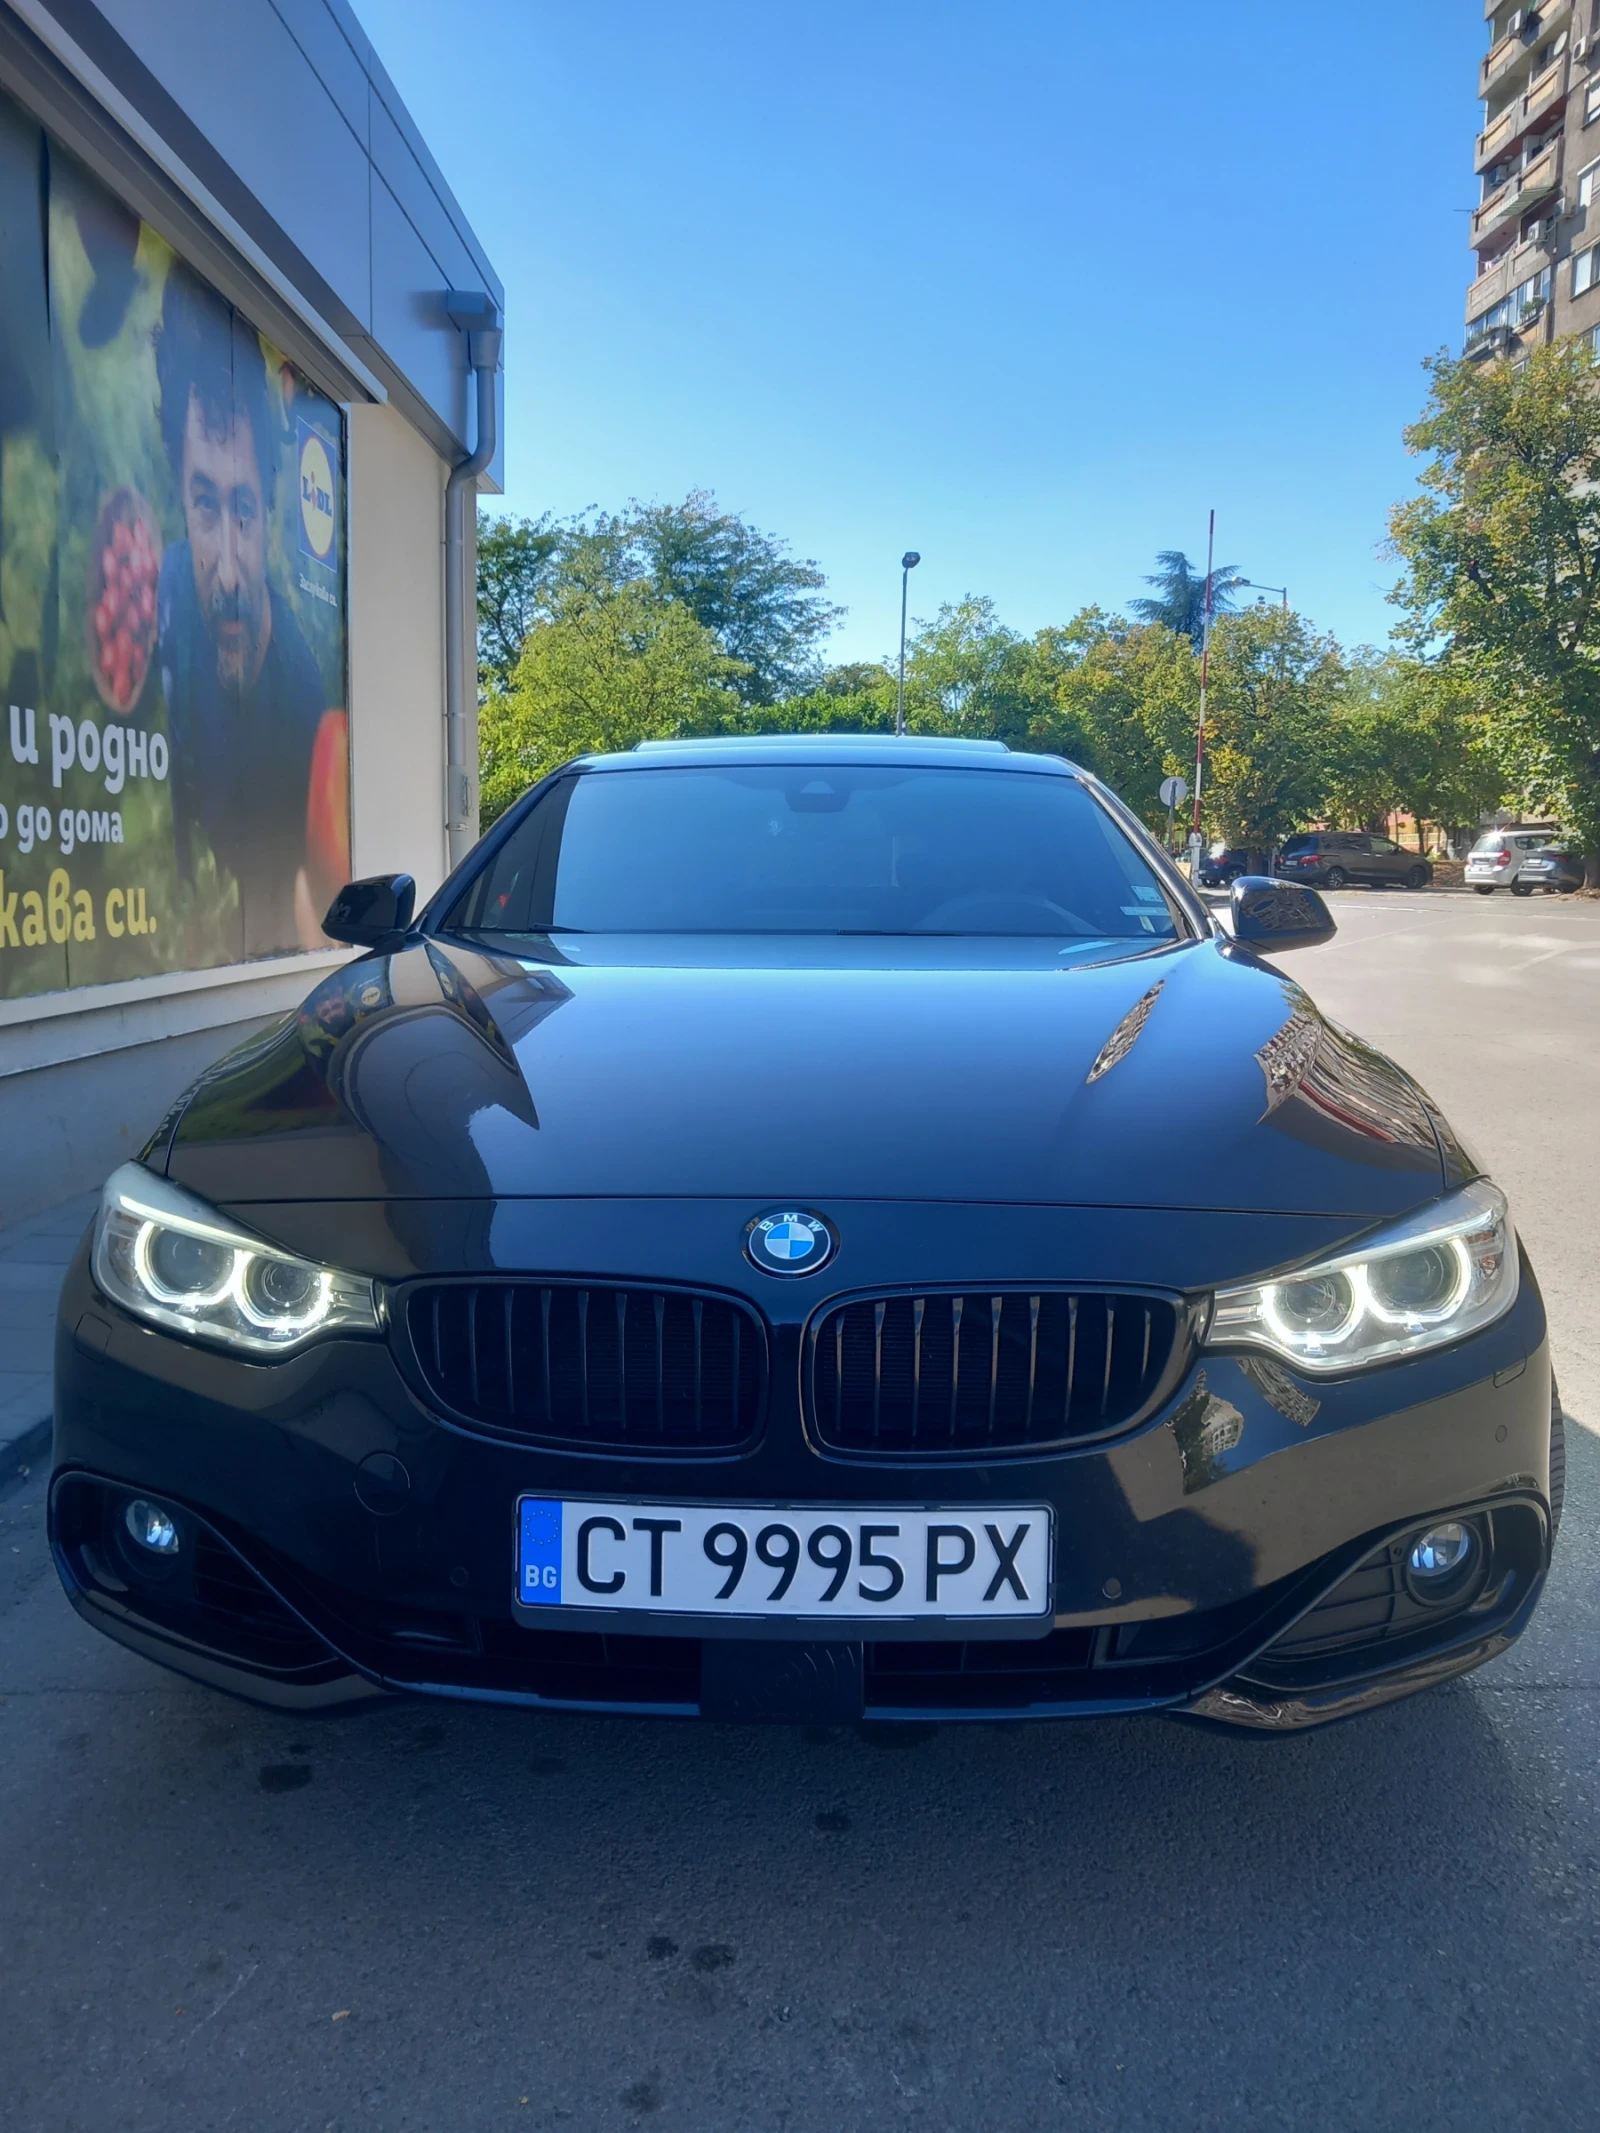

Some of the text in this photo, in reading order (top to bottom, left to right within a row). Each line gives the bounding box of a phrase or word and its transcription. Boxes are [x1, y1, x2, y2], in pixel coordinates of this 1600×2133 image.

[10, 705, 169, 794] и родно
[16, 804, 52, 854] до
[59, 808, 125, 855] дома
[105, 887, 157, 938] си.
[759, 1214, 824, 1233] BMW
[525, 1564, 557, 1588] BG
[702, 1522, 906, 1603] 9995
